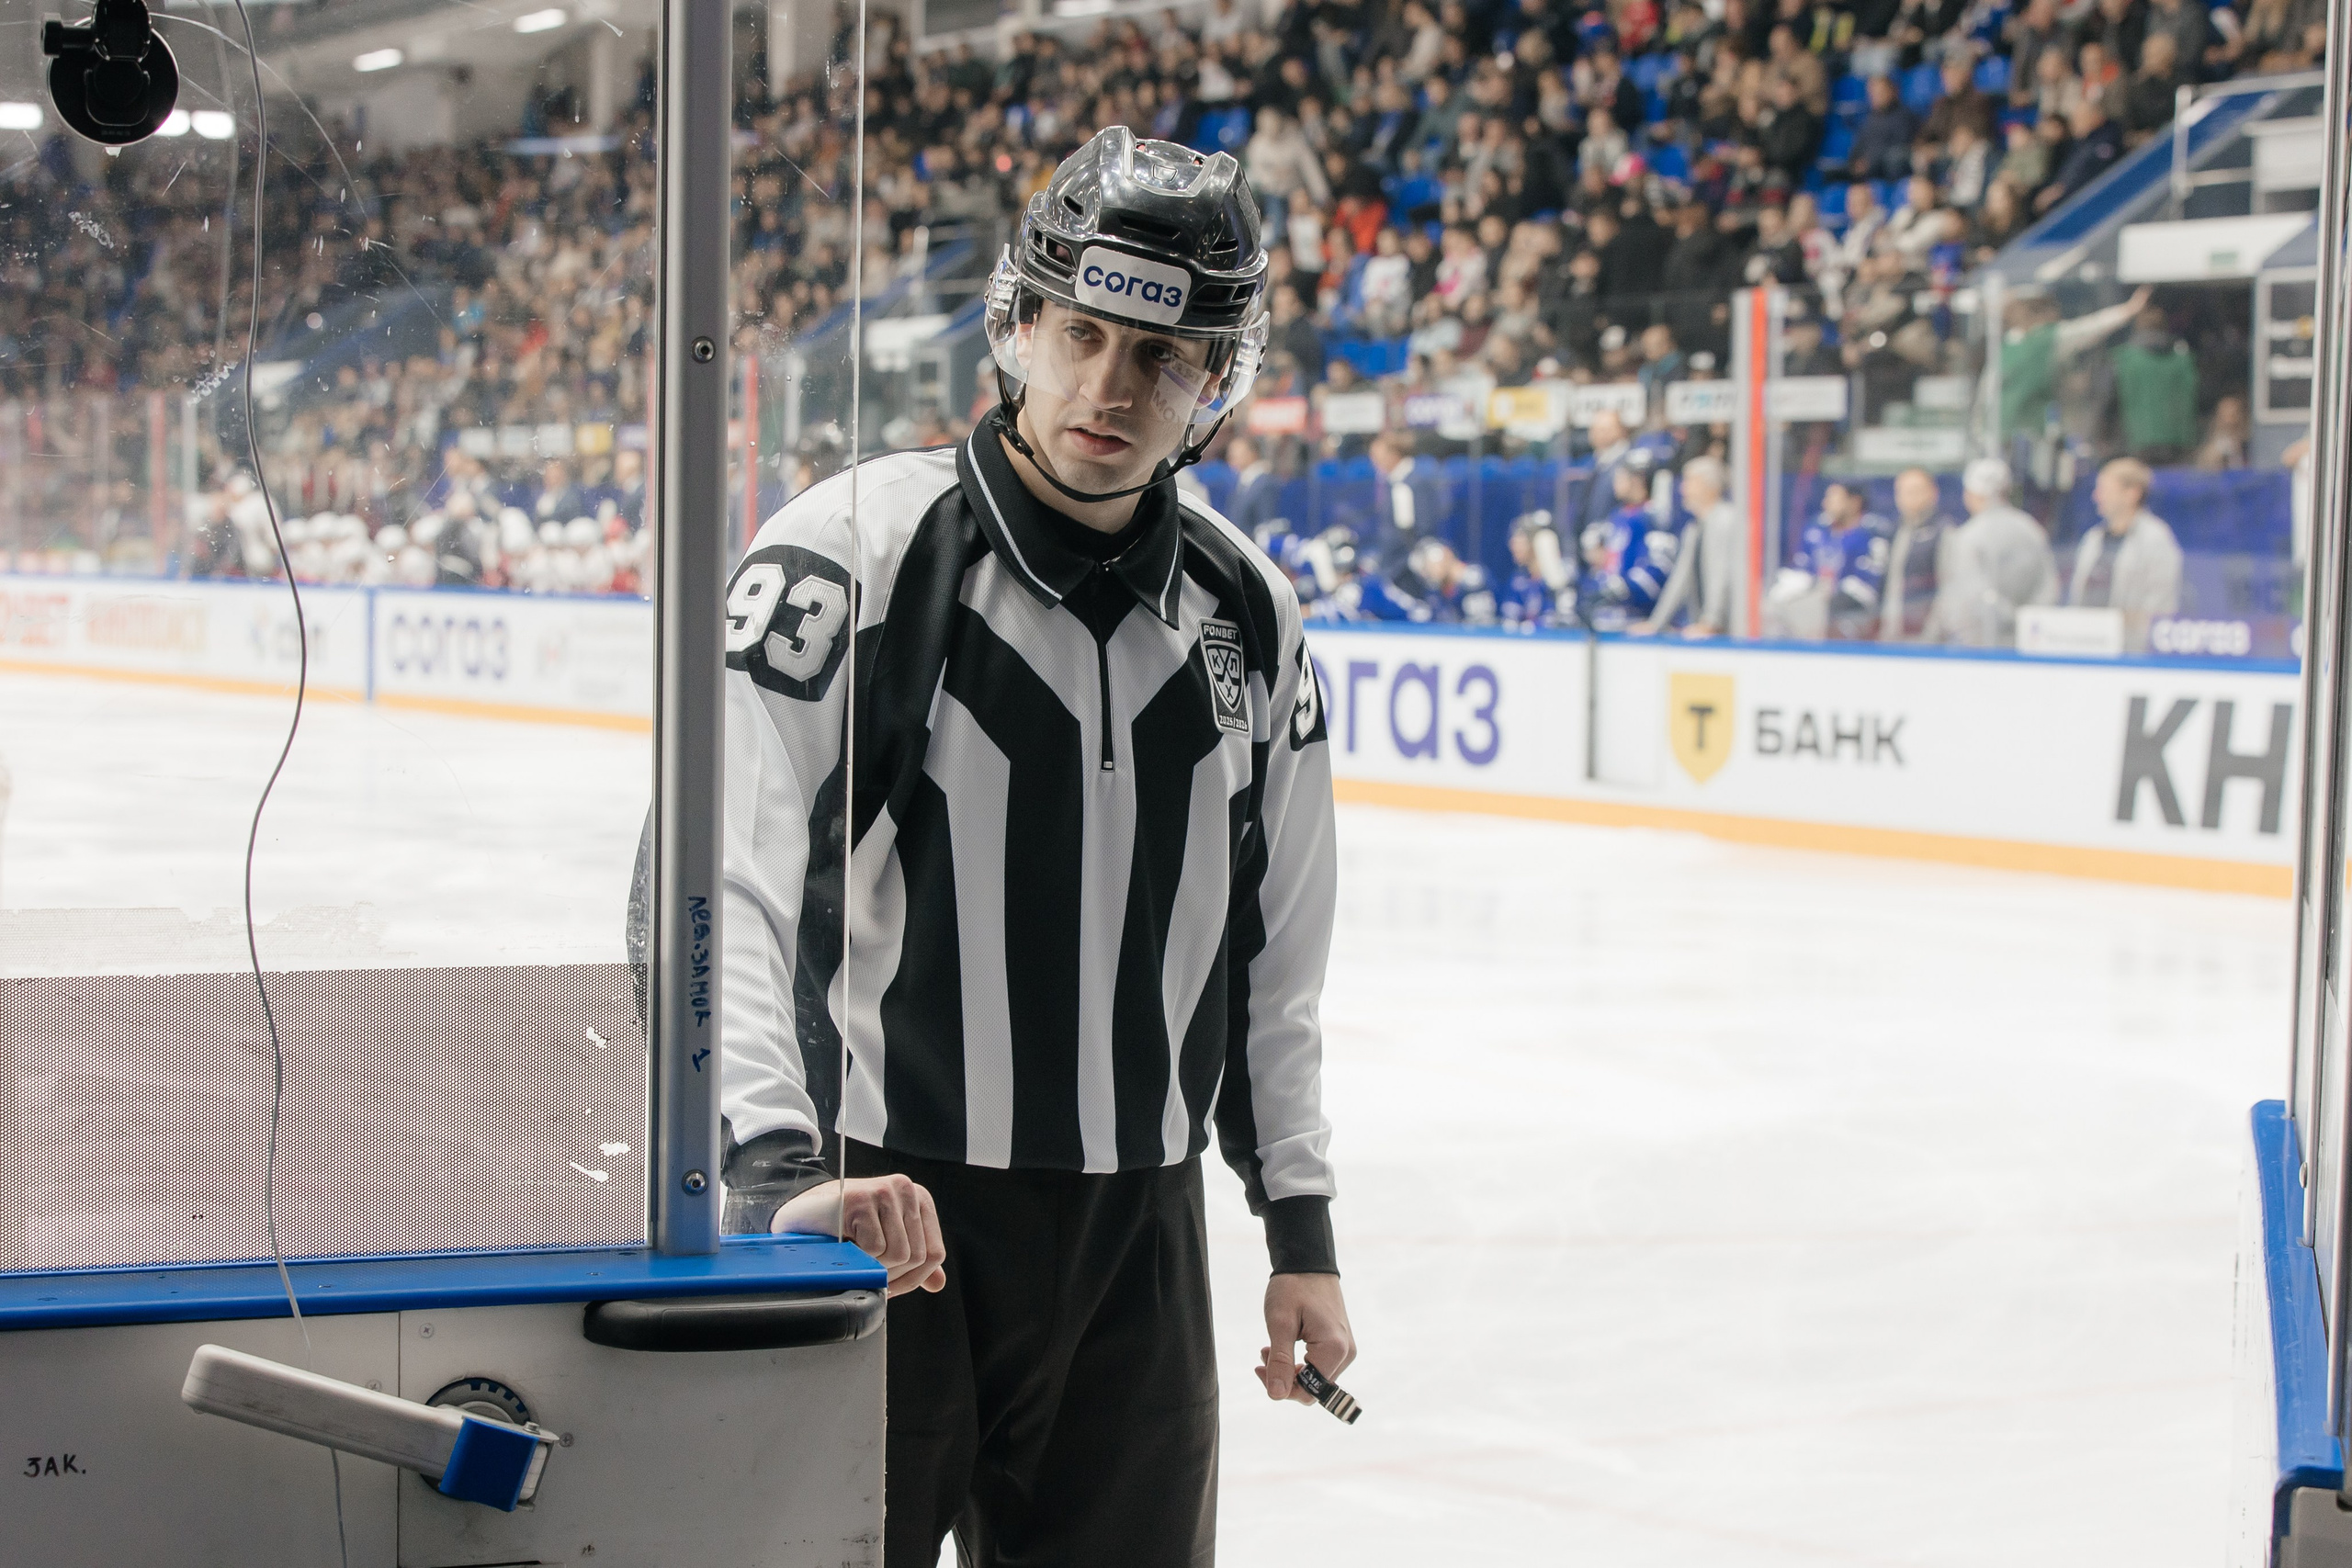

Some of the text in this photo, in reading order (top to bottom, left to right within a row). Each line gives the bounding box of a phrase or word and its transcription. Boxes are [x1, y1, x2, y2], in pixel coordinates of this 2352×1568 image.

[1083, 265, 1182, 308] согаз
[726, 563, 849, 682] 93
[1204, 625, 1238, 639] FONBET
[1219, 716, 1248, 730] 2025/2026
[1687, 704, 1908, 765] Т БАНК
[23, 1453, 86, 1478] ЗАК.
